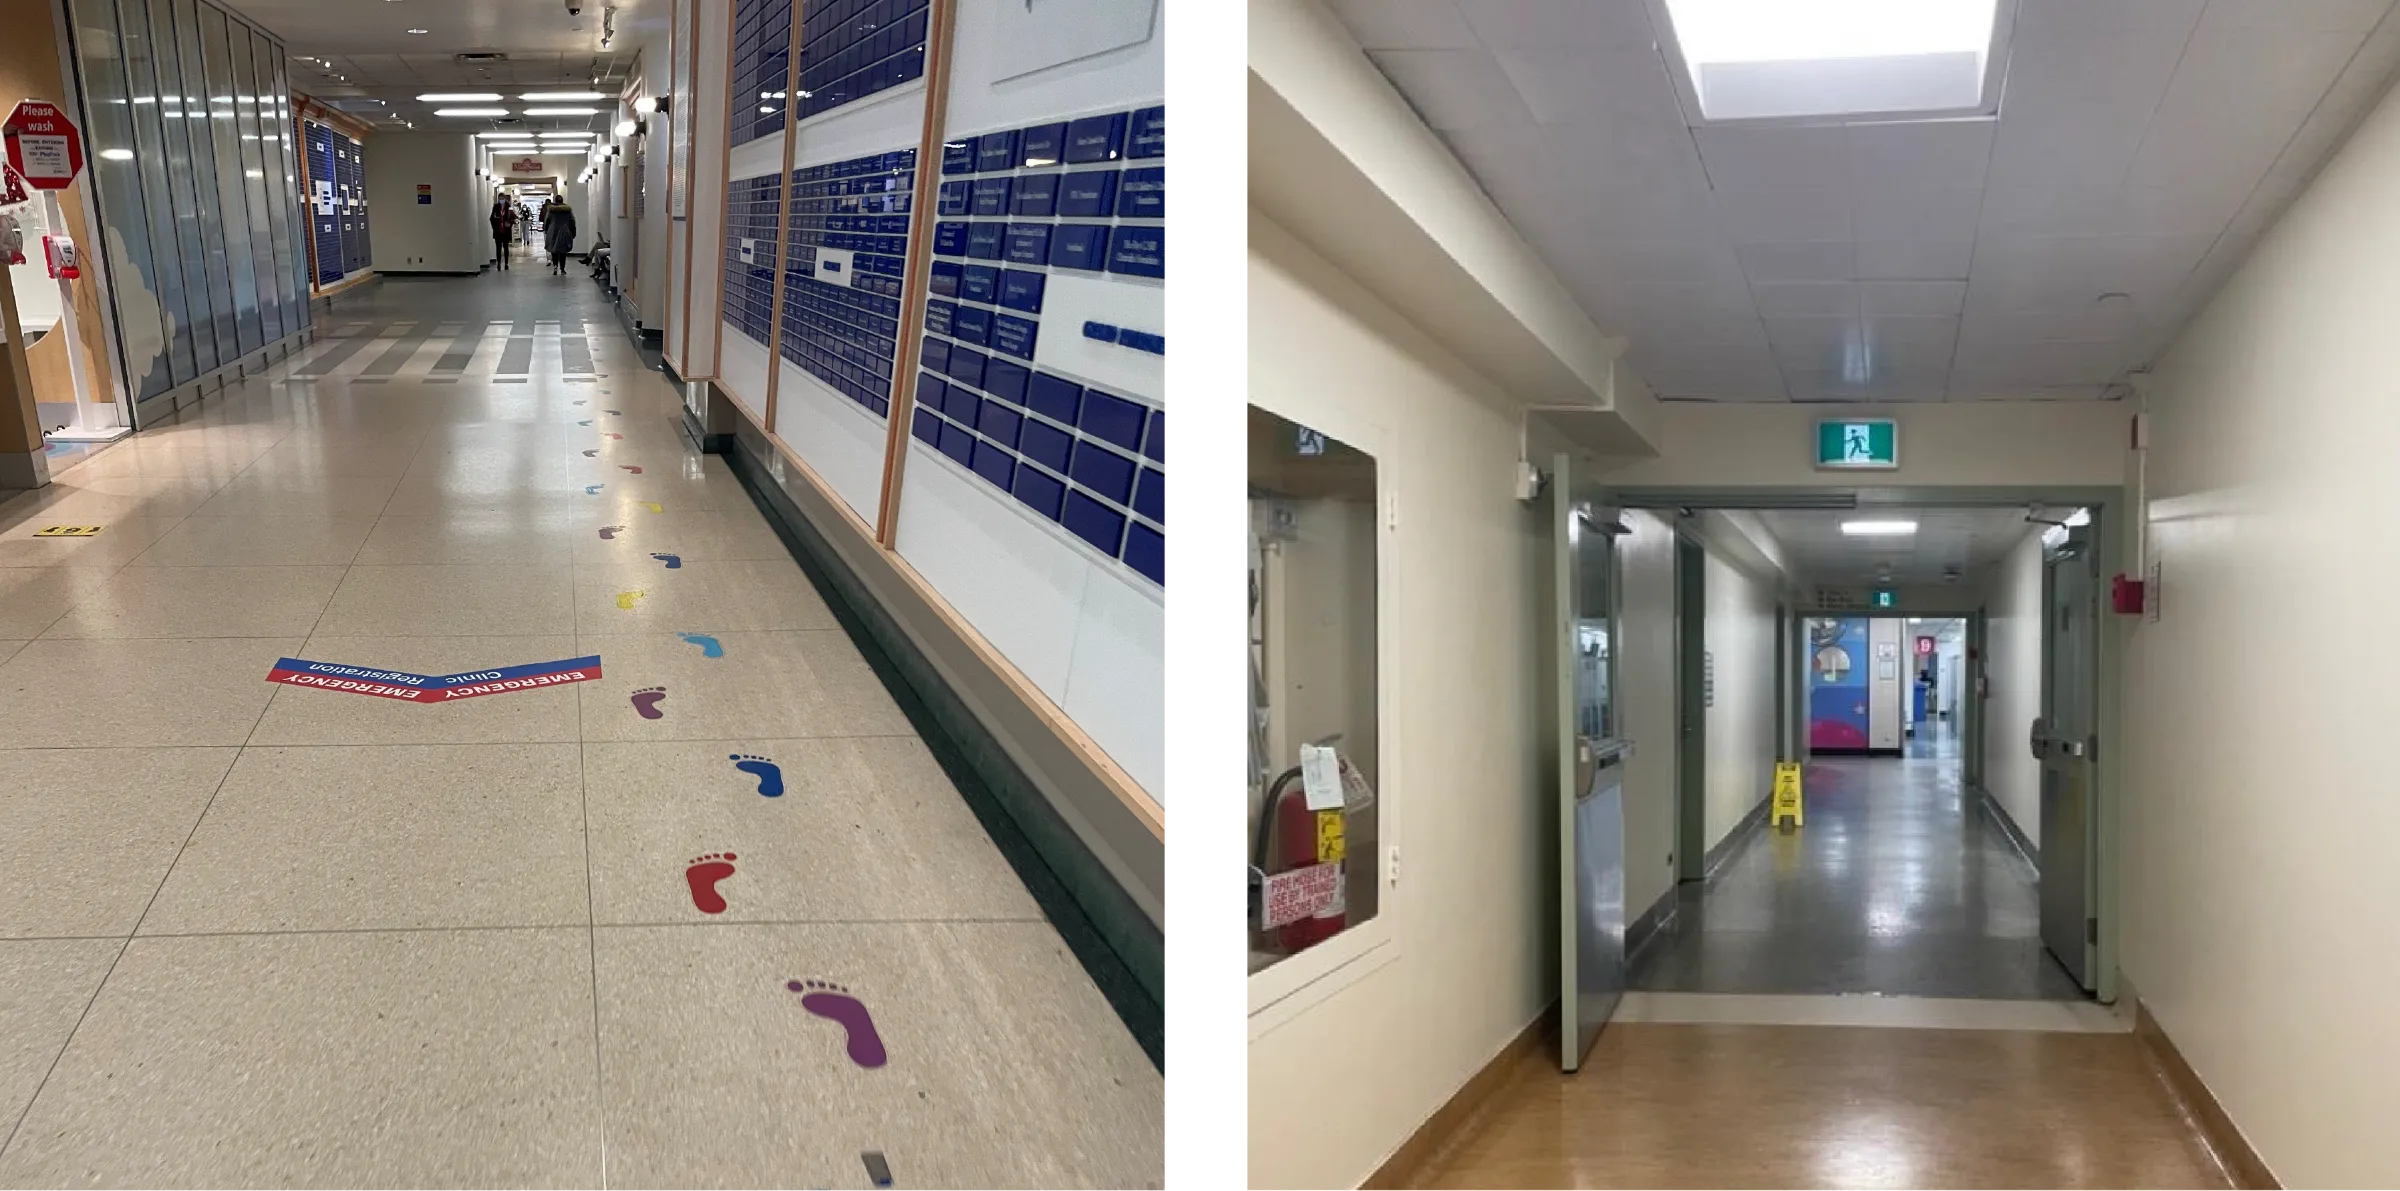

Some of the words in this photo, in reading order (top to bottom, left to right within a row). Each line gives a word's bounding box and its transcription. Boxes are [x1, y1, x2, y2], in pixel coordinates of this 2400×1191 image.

[22, 105, 54, 116] Please
[28, 120, 54, 132] wash
[309, 663, 425, 686] Registration
[445, 671, 502, 684] Clinic
[282, 674, 421, 699] EMERGENCY
[445, 671, 585, 698] EMERGENCY
